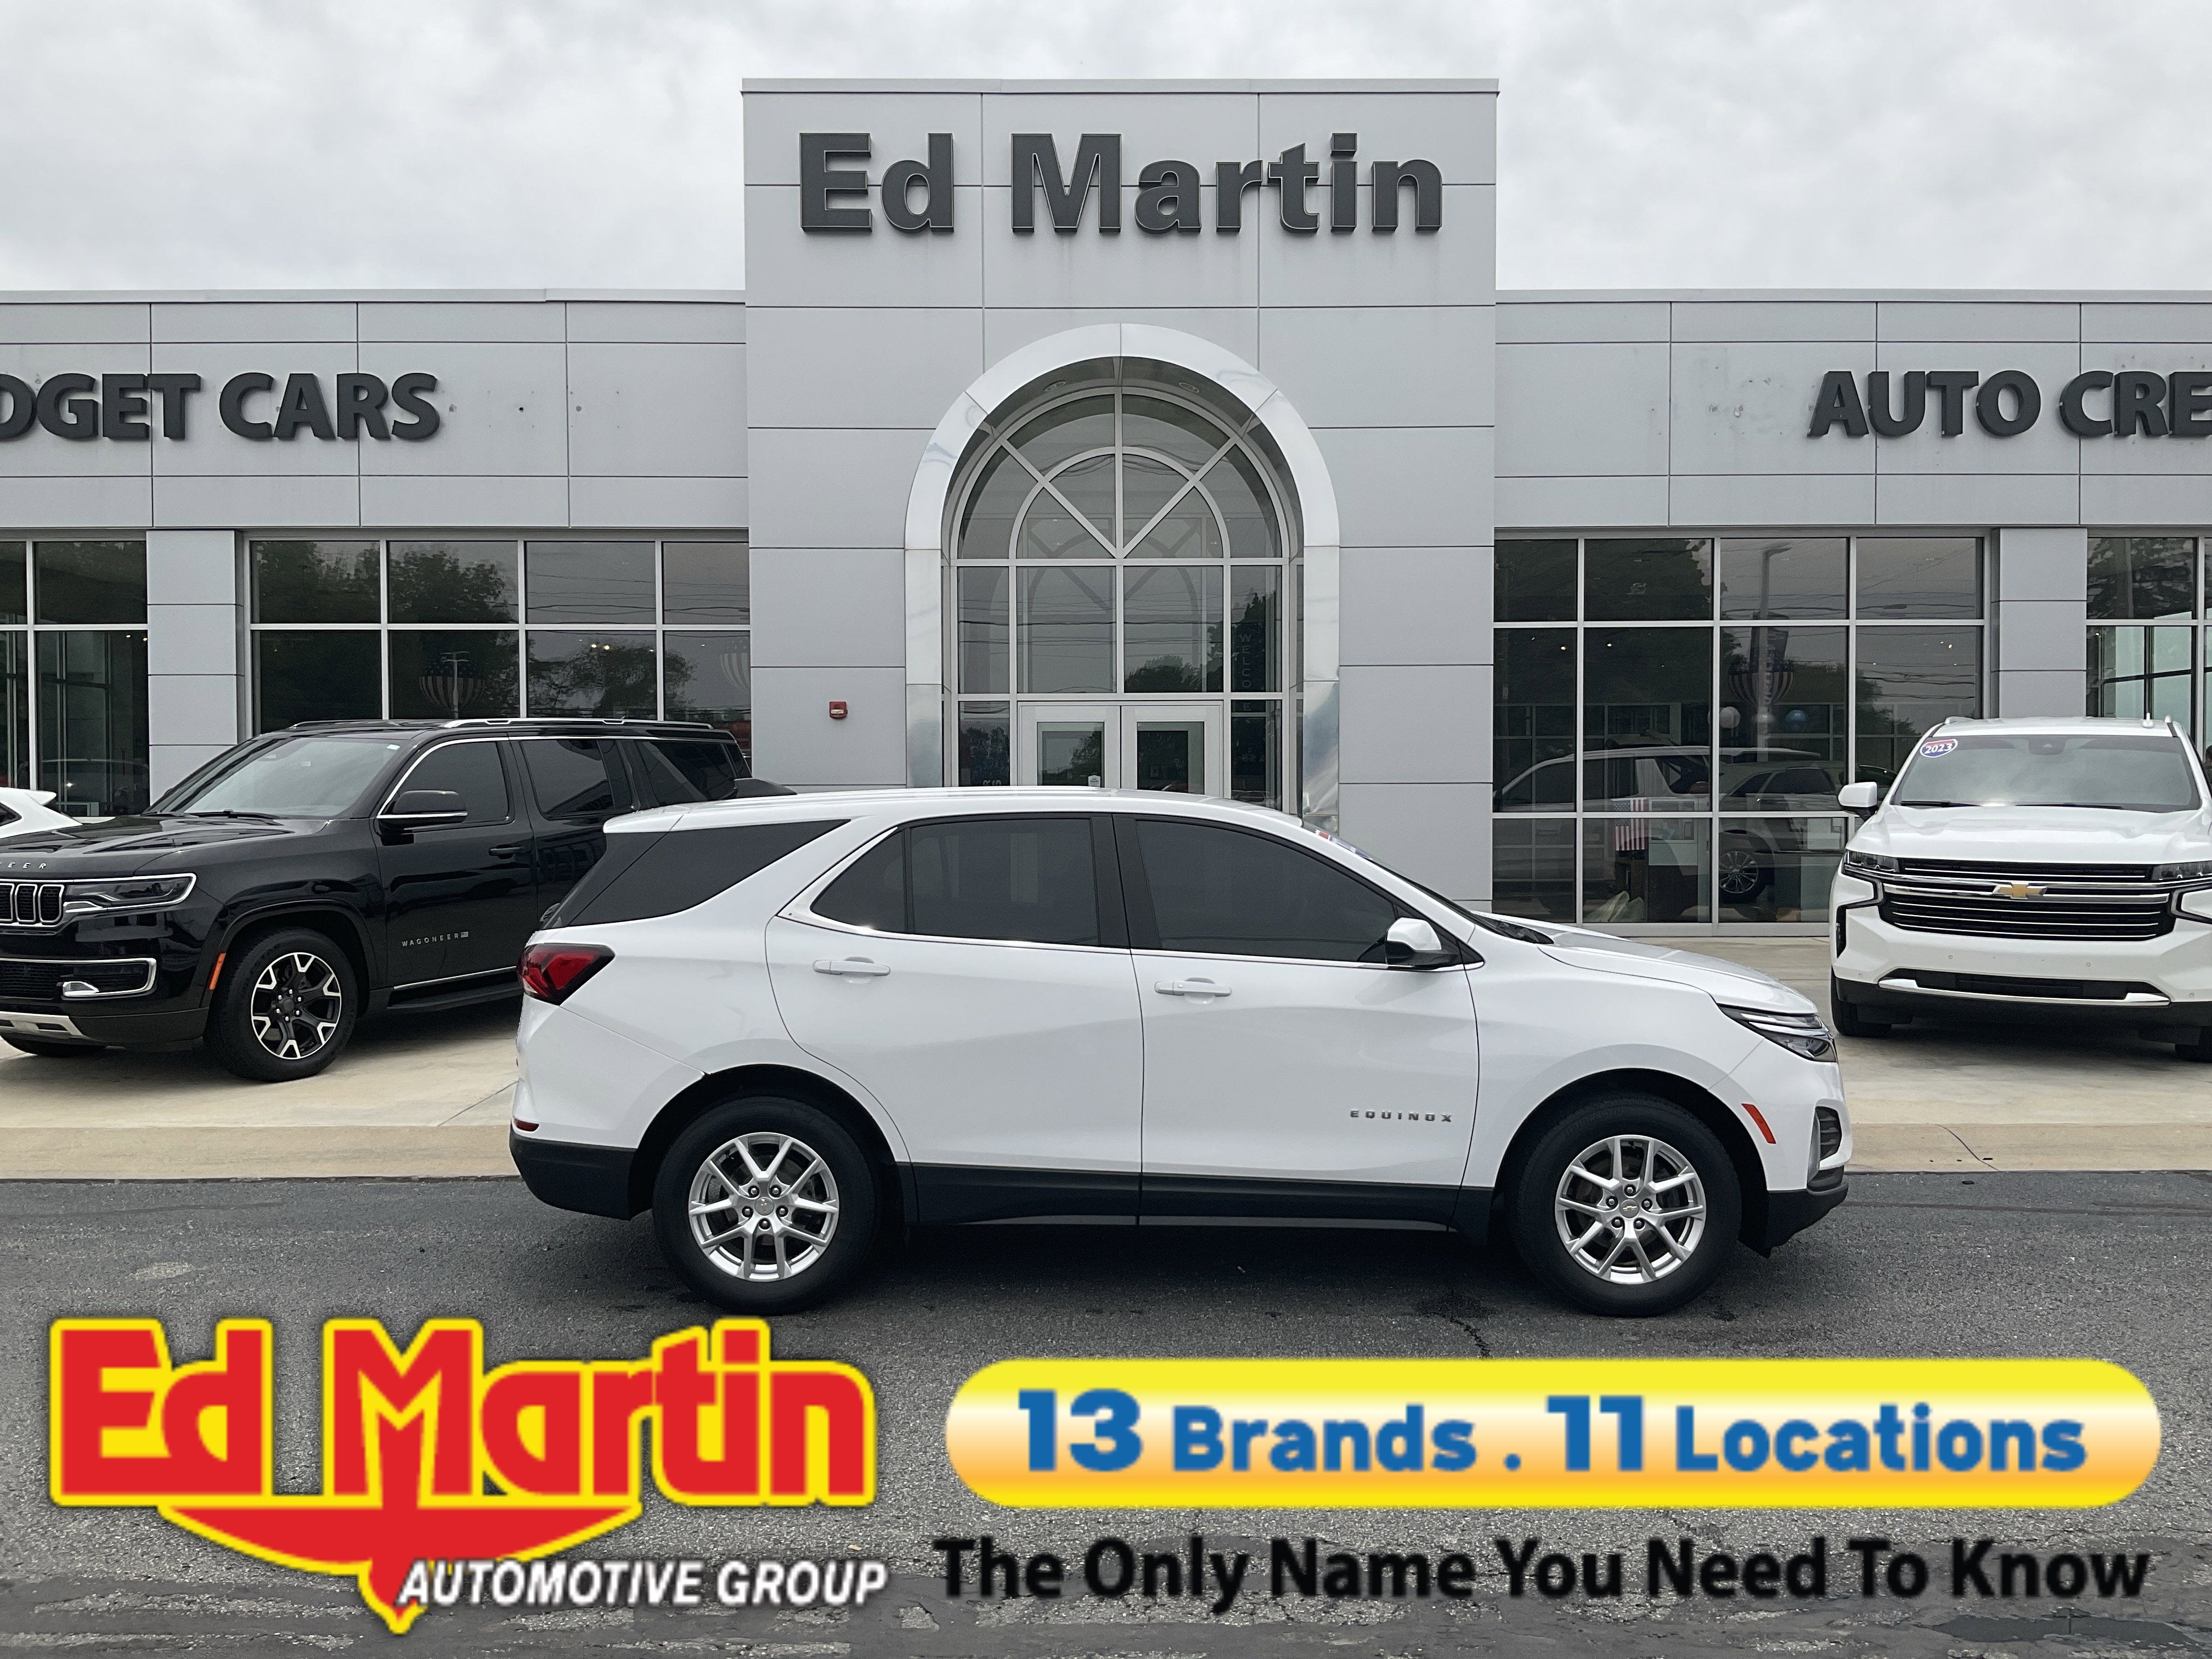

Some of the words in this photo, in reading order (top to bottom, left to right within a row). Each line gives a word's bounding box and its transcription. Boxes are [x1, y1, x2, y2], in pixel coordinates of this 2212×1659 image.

[799, 132, 955, 234] Ed
[1011, 132, 1442, 234] Martin
[219, 371, 441, 441] CARS
[1808, 370, 2041, 438] AUTO
[1238, 633, 1252, 712] WELCOE
[1925, 743, 1953, 754] 2023
[0, 861, 47, 870] EER
[401, 933, 459, 947] WAGONEER
[1350, 1109, 1452, 1122] EQUINOX
